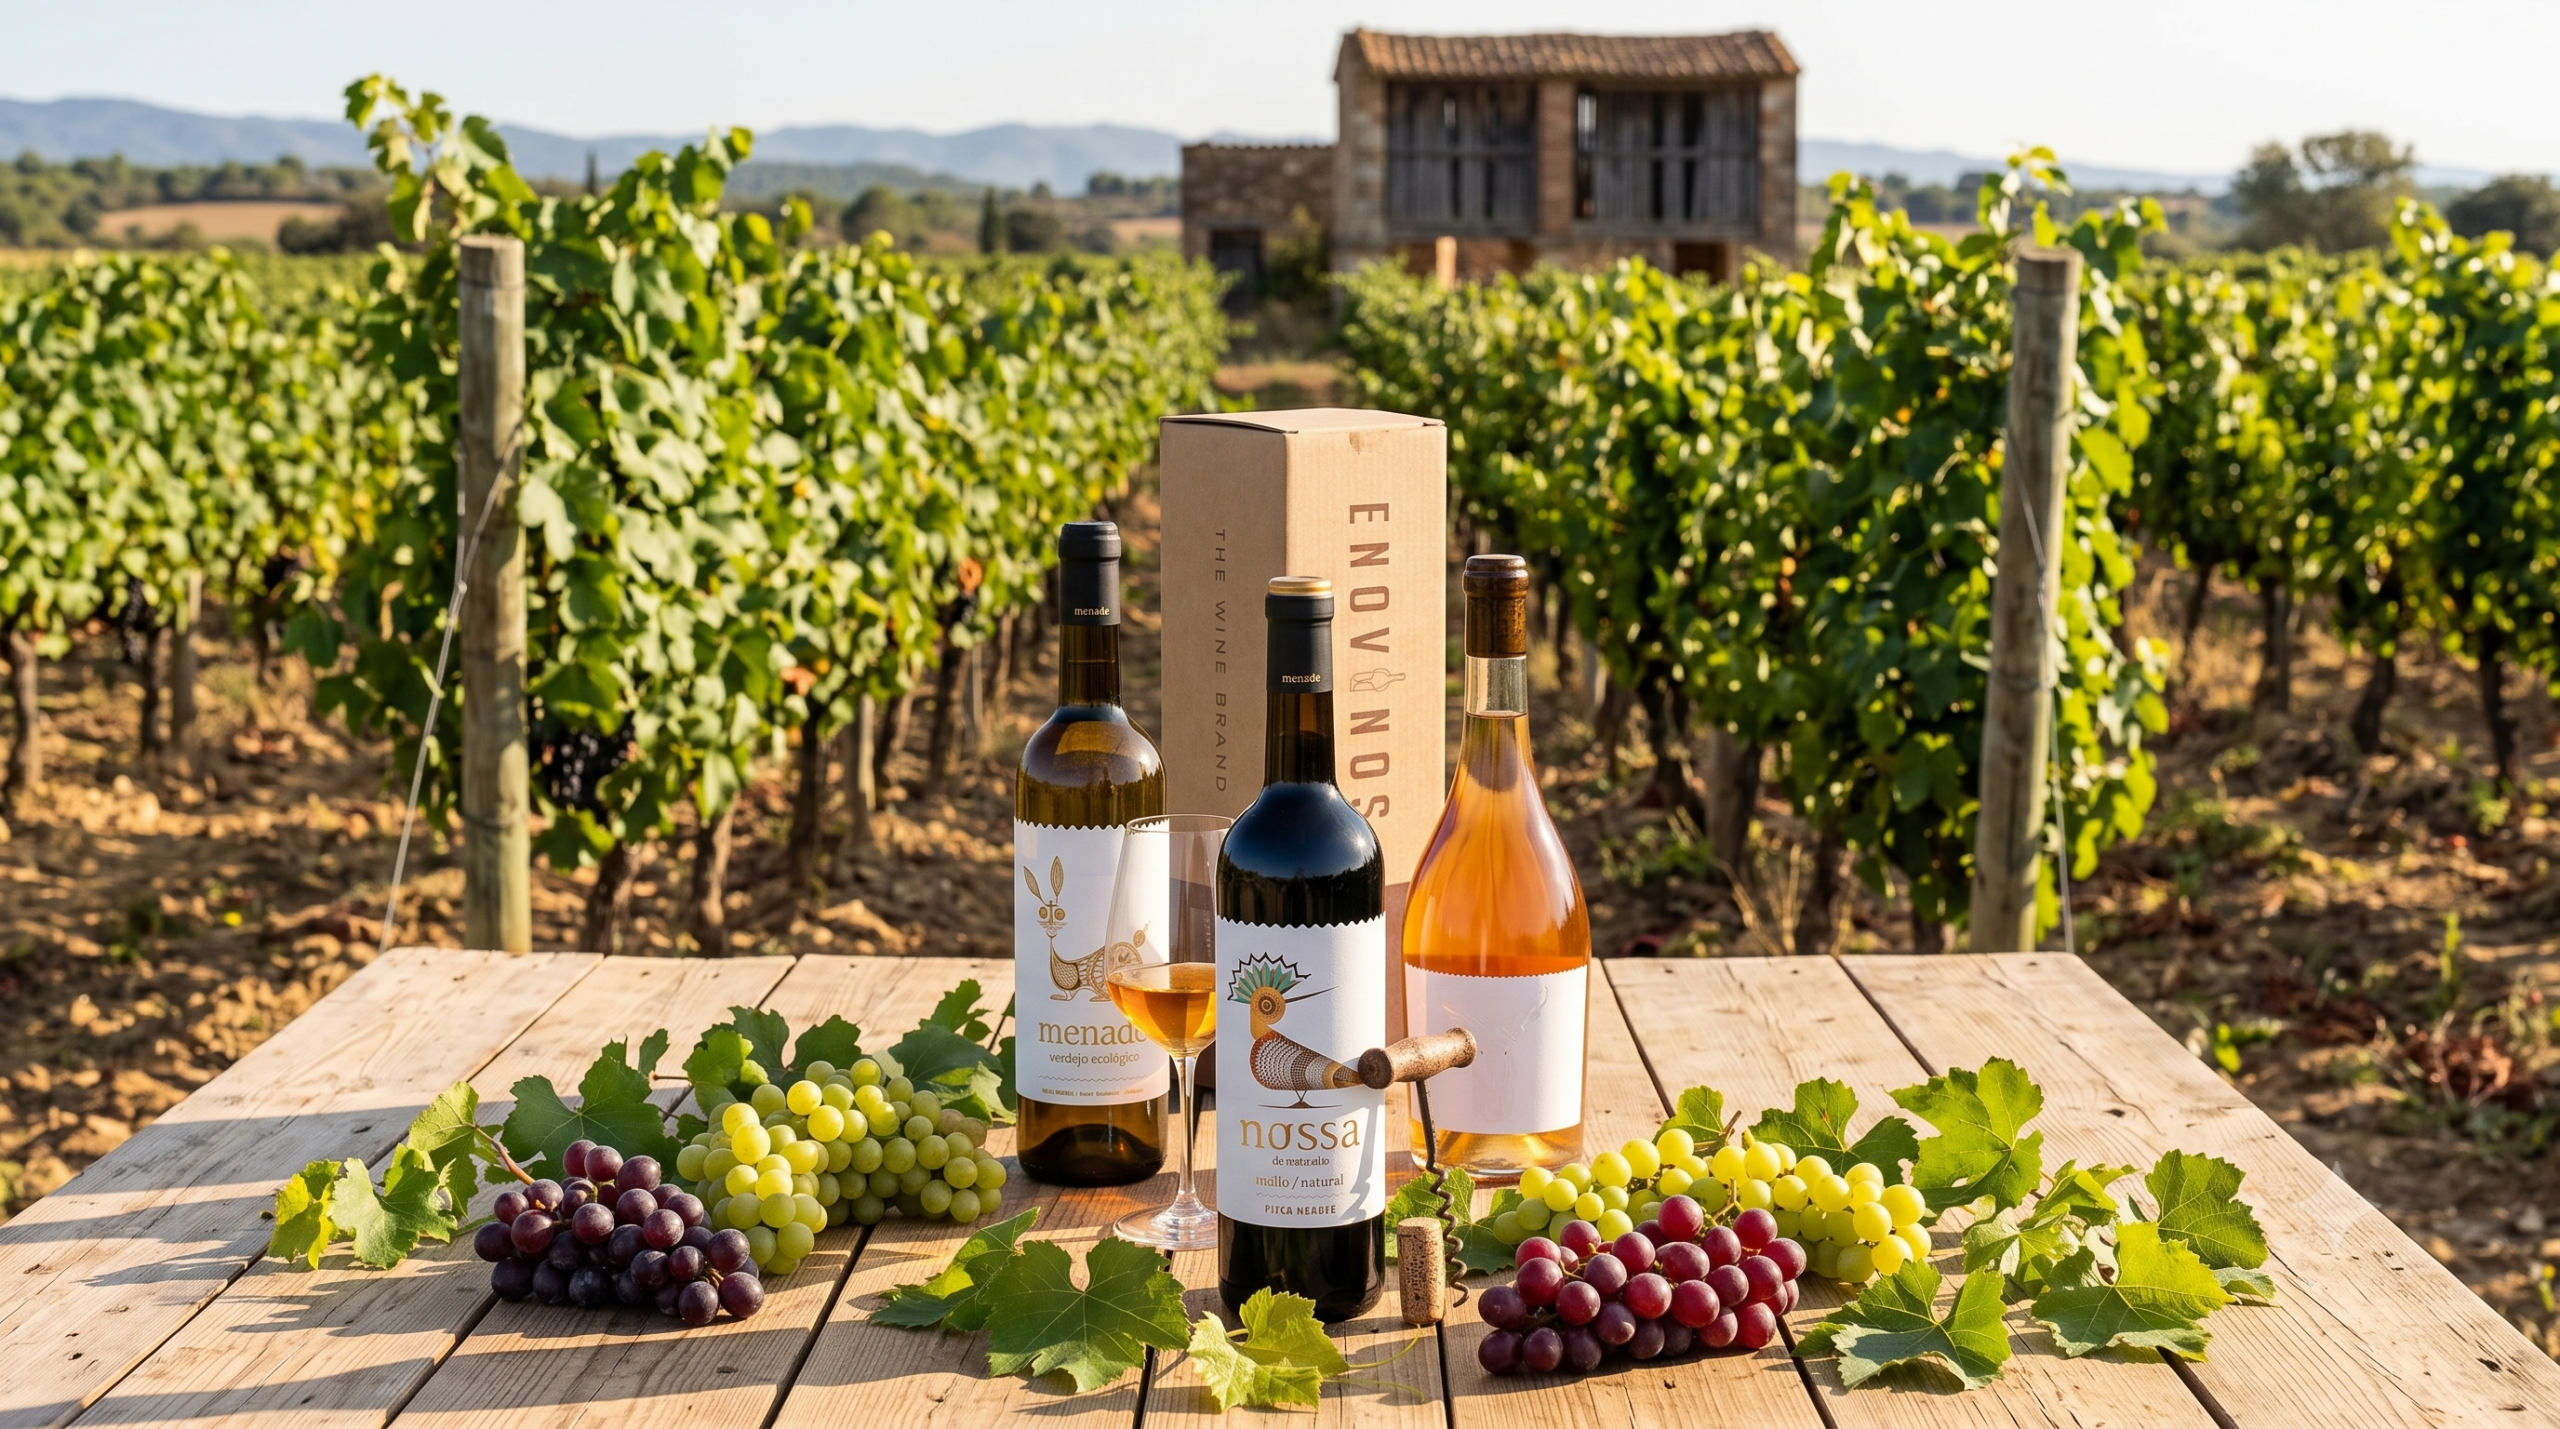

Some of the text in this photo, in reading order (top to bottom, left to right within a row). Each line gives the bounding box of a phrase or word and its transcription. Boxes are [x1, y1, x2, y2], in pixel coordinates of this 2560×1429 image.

[1074, 606, 1110, 616] menade
[1215, 529, 1227, 792] THE WINE BRAND
[1049, 1052, 1140, 1067] verdejo ecológico
[1300, 1173, 1344, 1188] natural
